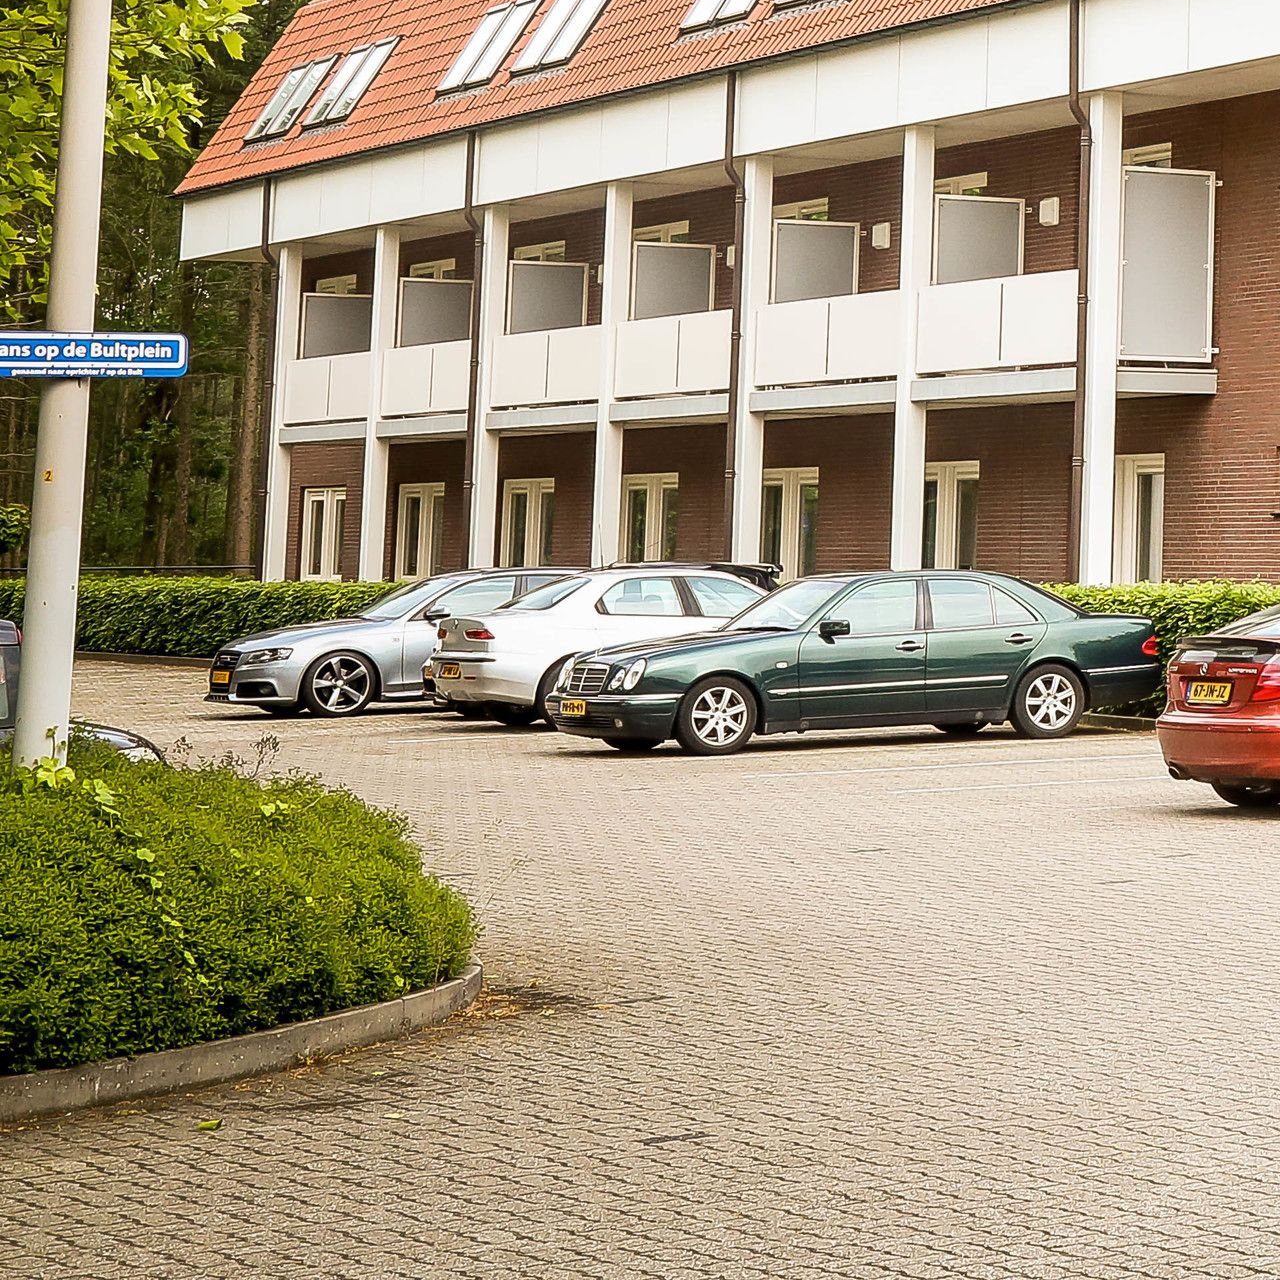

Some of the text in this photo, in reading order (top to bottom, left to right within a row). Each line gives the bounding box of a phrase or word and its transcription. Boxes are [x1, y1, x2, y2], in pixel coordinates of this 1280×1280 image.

[34, 344, 59, 361] op
[63, 342, 87, 358] de
[90, 342, 172, 361] Bultplein
[1193, 684, 1228, 698] 67-JN-JZ
